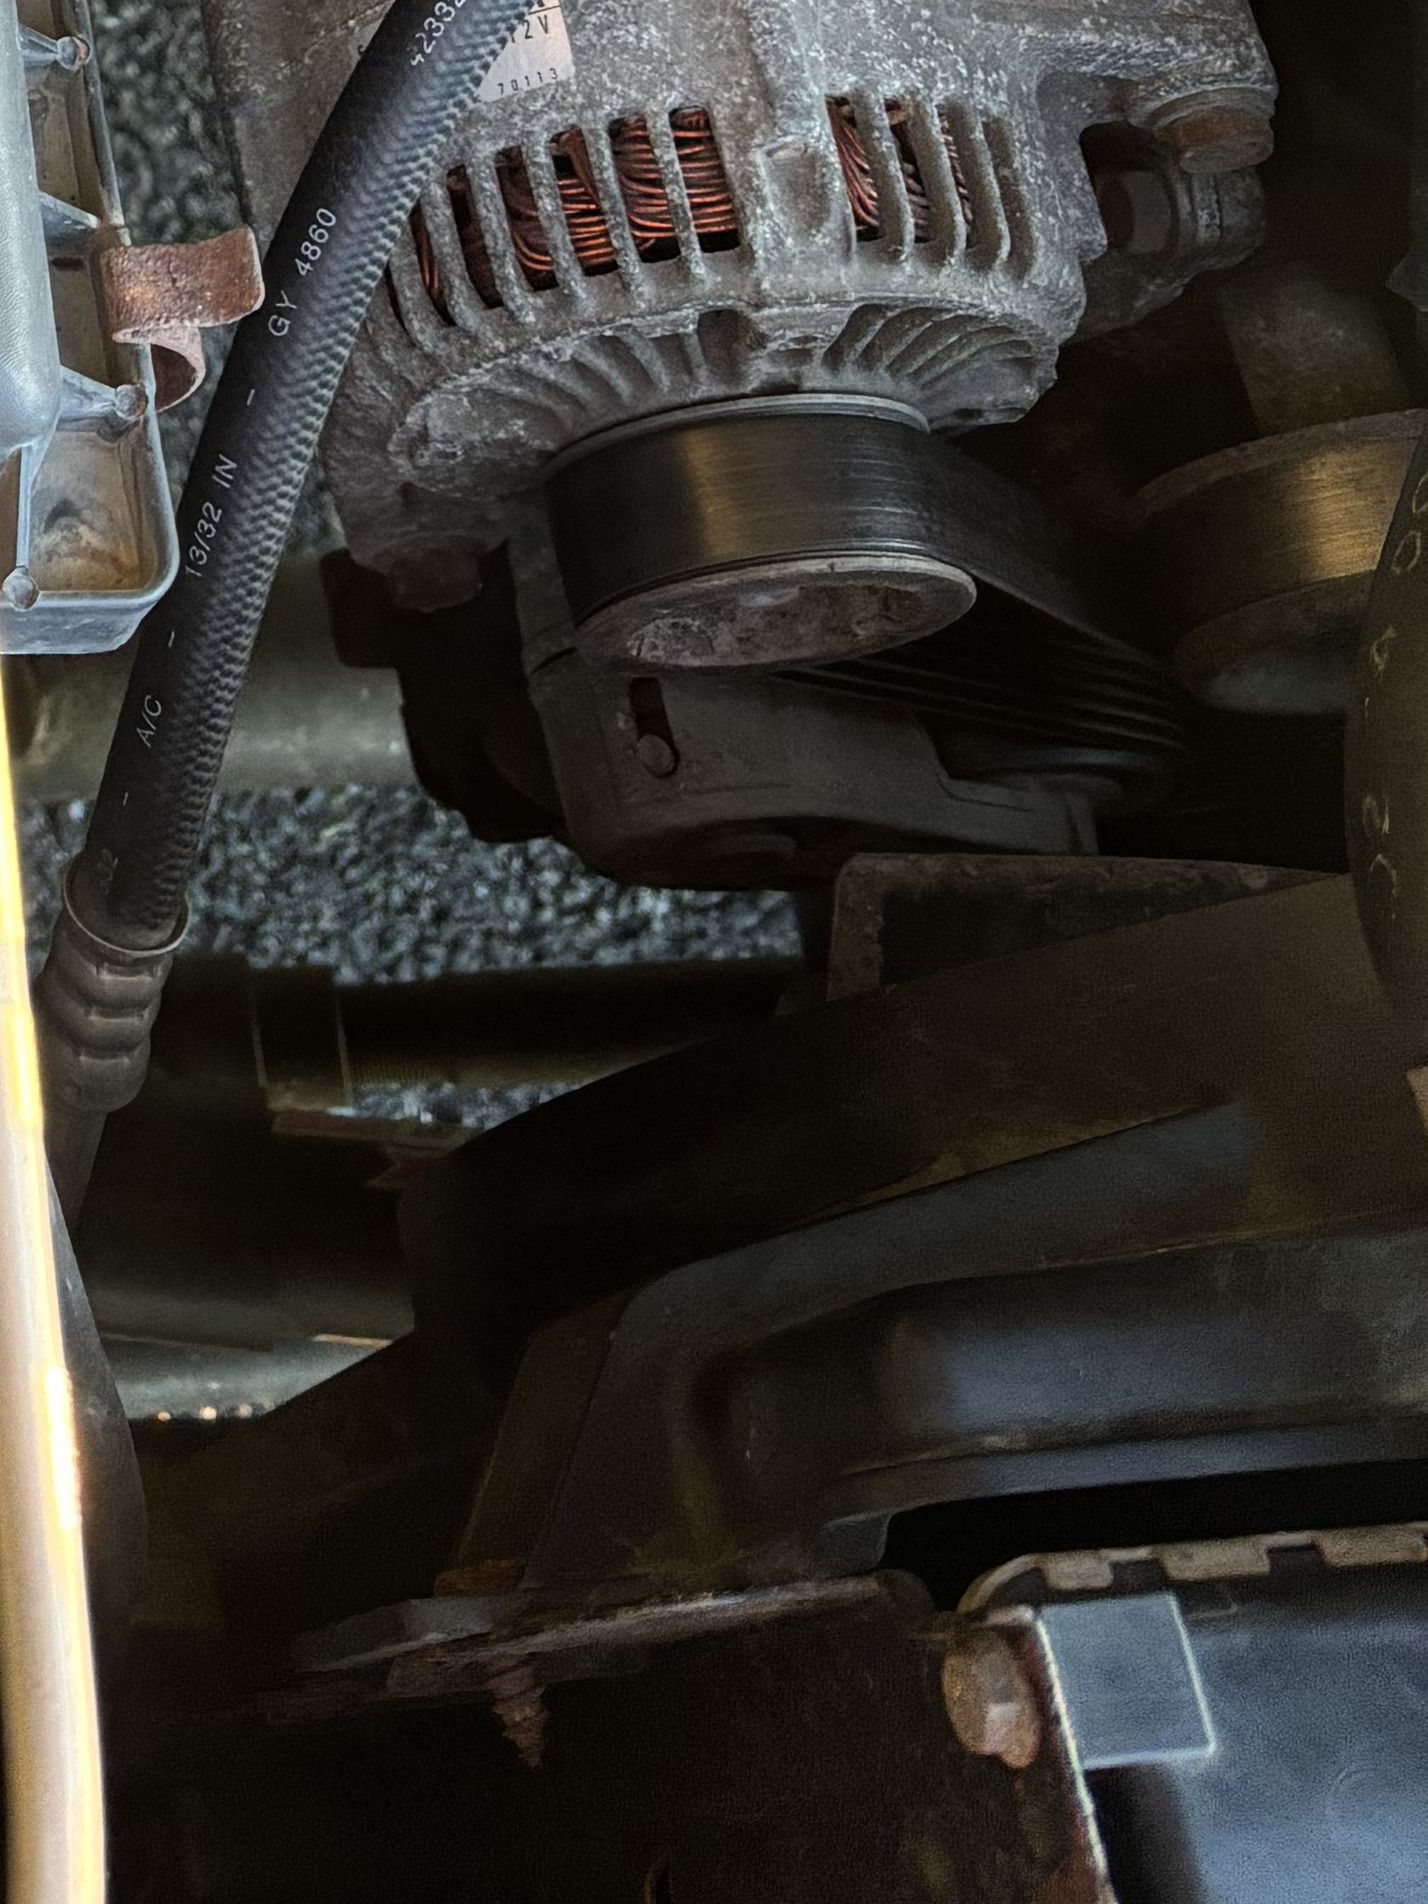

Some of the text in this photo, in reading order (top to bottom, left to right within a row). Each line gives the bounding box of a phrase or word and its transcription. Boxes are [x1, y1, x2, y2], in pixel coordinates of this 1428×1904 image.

[134, 694, 166, 749] A/C
[184, 503, 223, 581] 13/32
[213, 452, 239, 488] IN
[265, 289, 299, 340] GY
[294, 205, 338, 280] 4860
